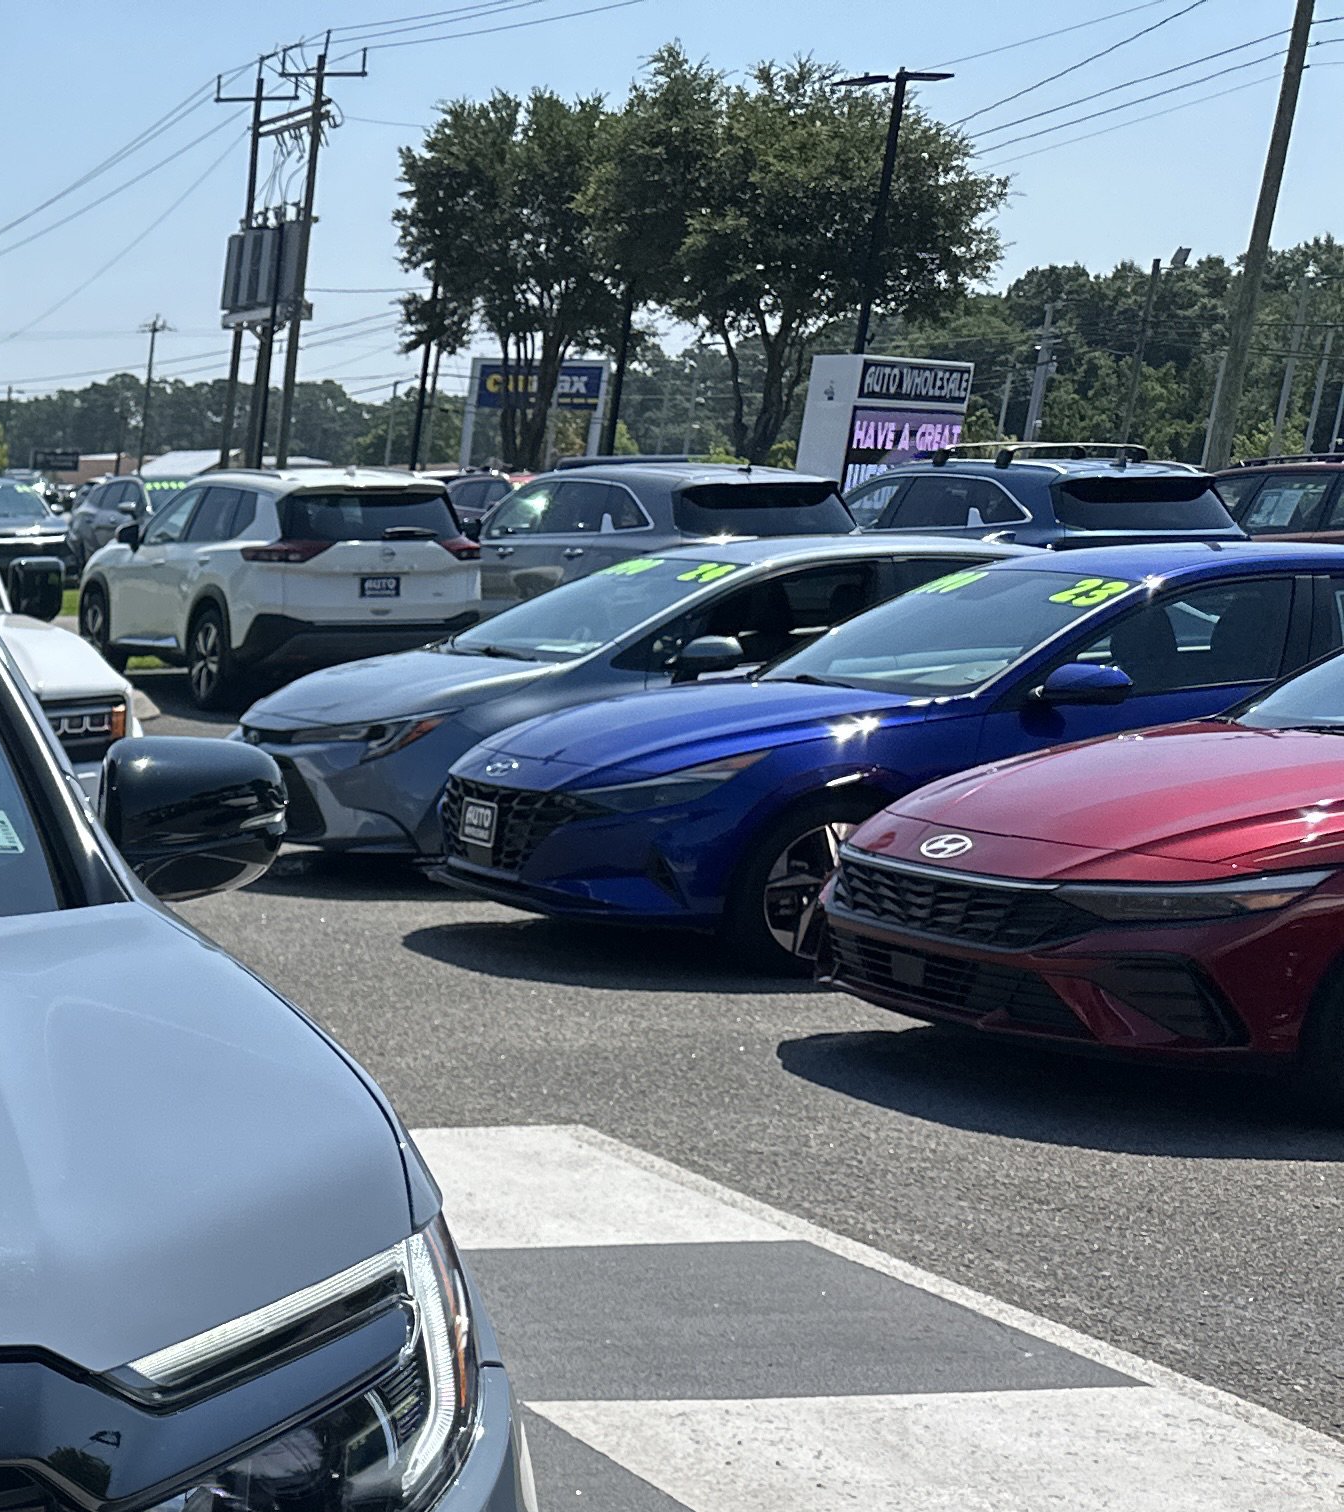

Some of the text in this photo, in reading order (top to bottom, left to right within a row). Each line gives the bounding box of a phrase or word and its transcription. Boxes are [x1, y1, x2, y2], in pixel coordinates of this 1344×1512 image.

[864, 365, 970, 399] AUTO WHOLESALE
[852, 420, 962, 451] HAVE A GREAT
[1048, 578, 1130, 608] 23
[465, 805, 492, 828] AUTO
